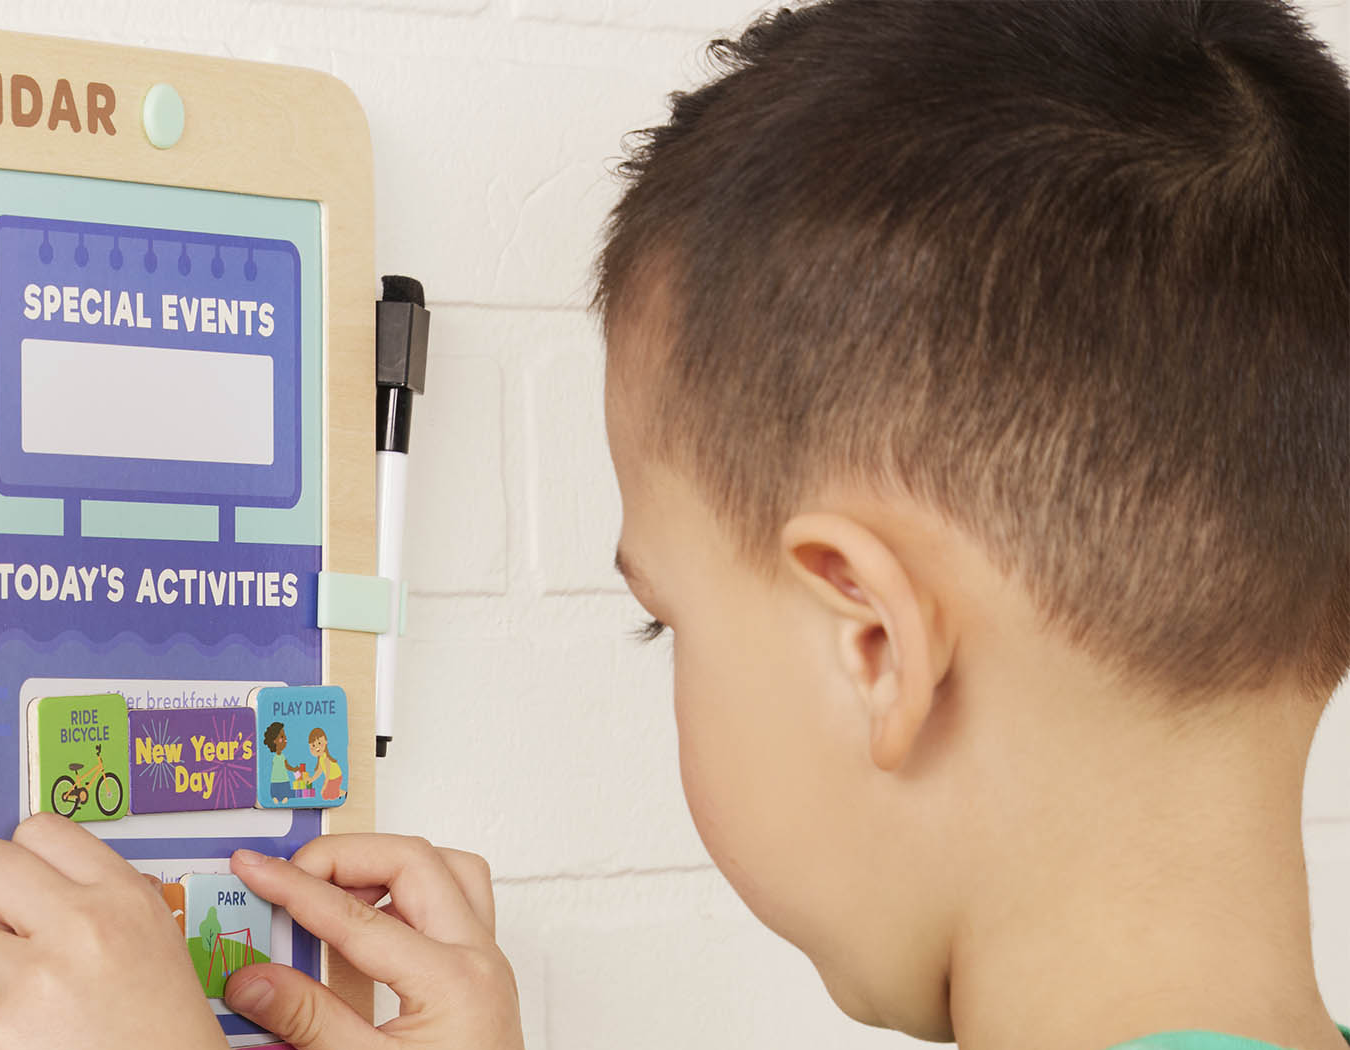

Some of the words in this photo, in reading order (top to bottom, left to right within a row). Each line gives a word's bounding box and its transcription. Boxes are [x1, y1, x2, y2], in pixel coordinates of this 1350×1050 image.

[23, 284, 152, 328] SPECIAL
[161, 295, 274, 337] EVENTS
[136, 568, 298, 607] ACTIVITIES
[71, 709, 99, 726] RIDE
[273, 702, 302, 717] PLAY
[305, 700, 336, 715] DATE
[60, 726, 110, 743] BICYCLE
[135, 737, 183, 765] New
[190, 732, 253, 762] Year's
[175, 766, 216, 800] Day
[217, 891, 247, 906] PARK
